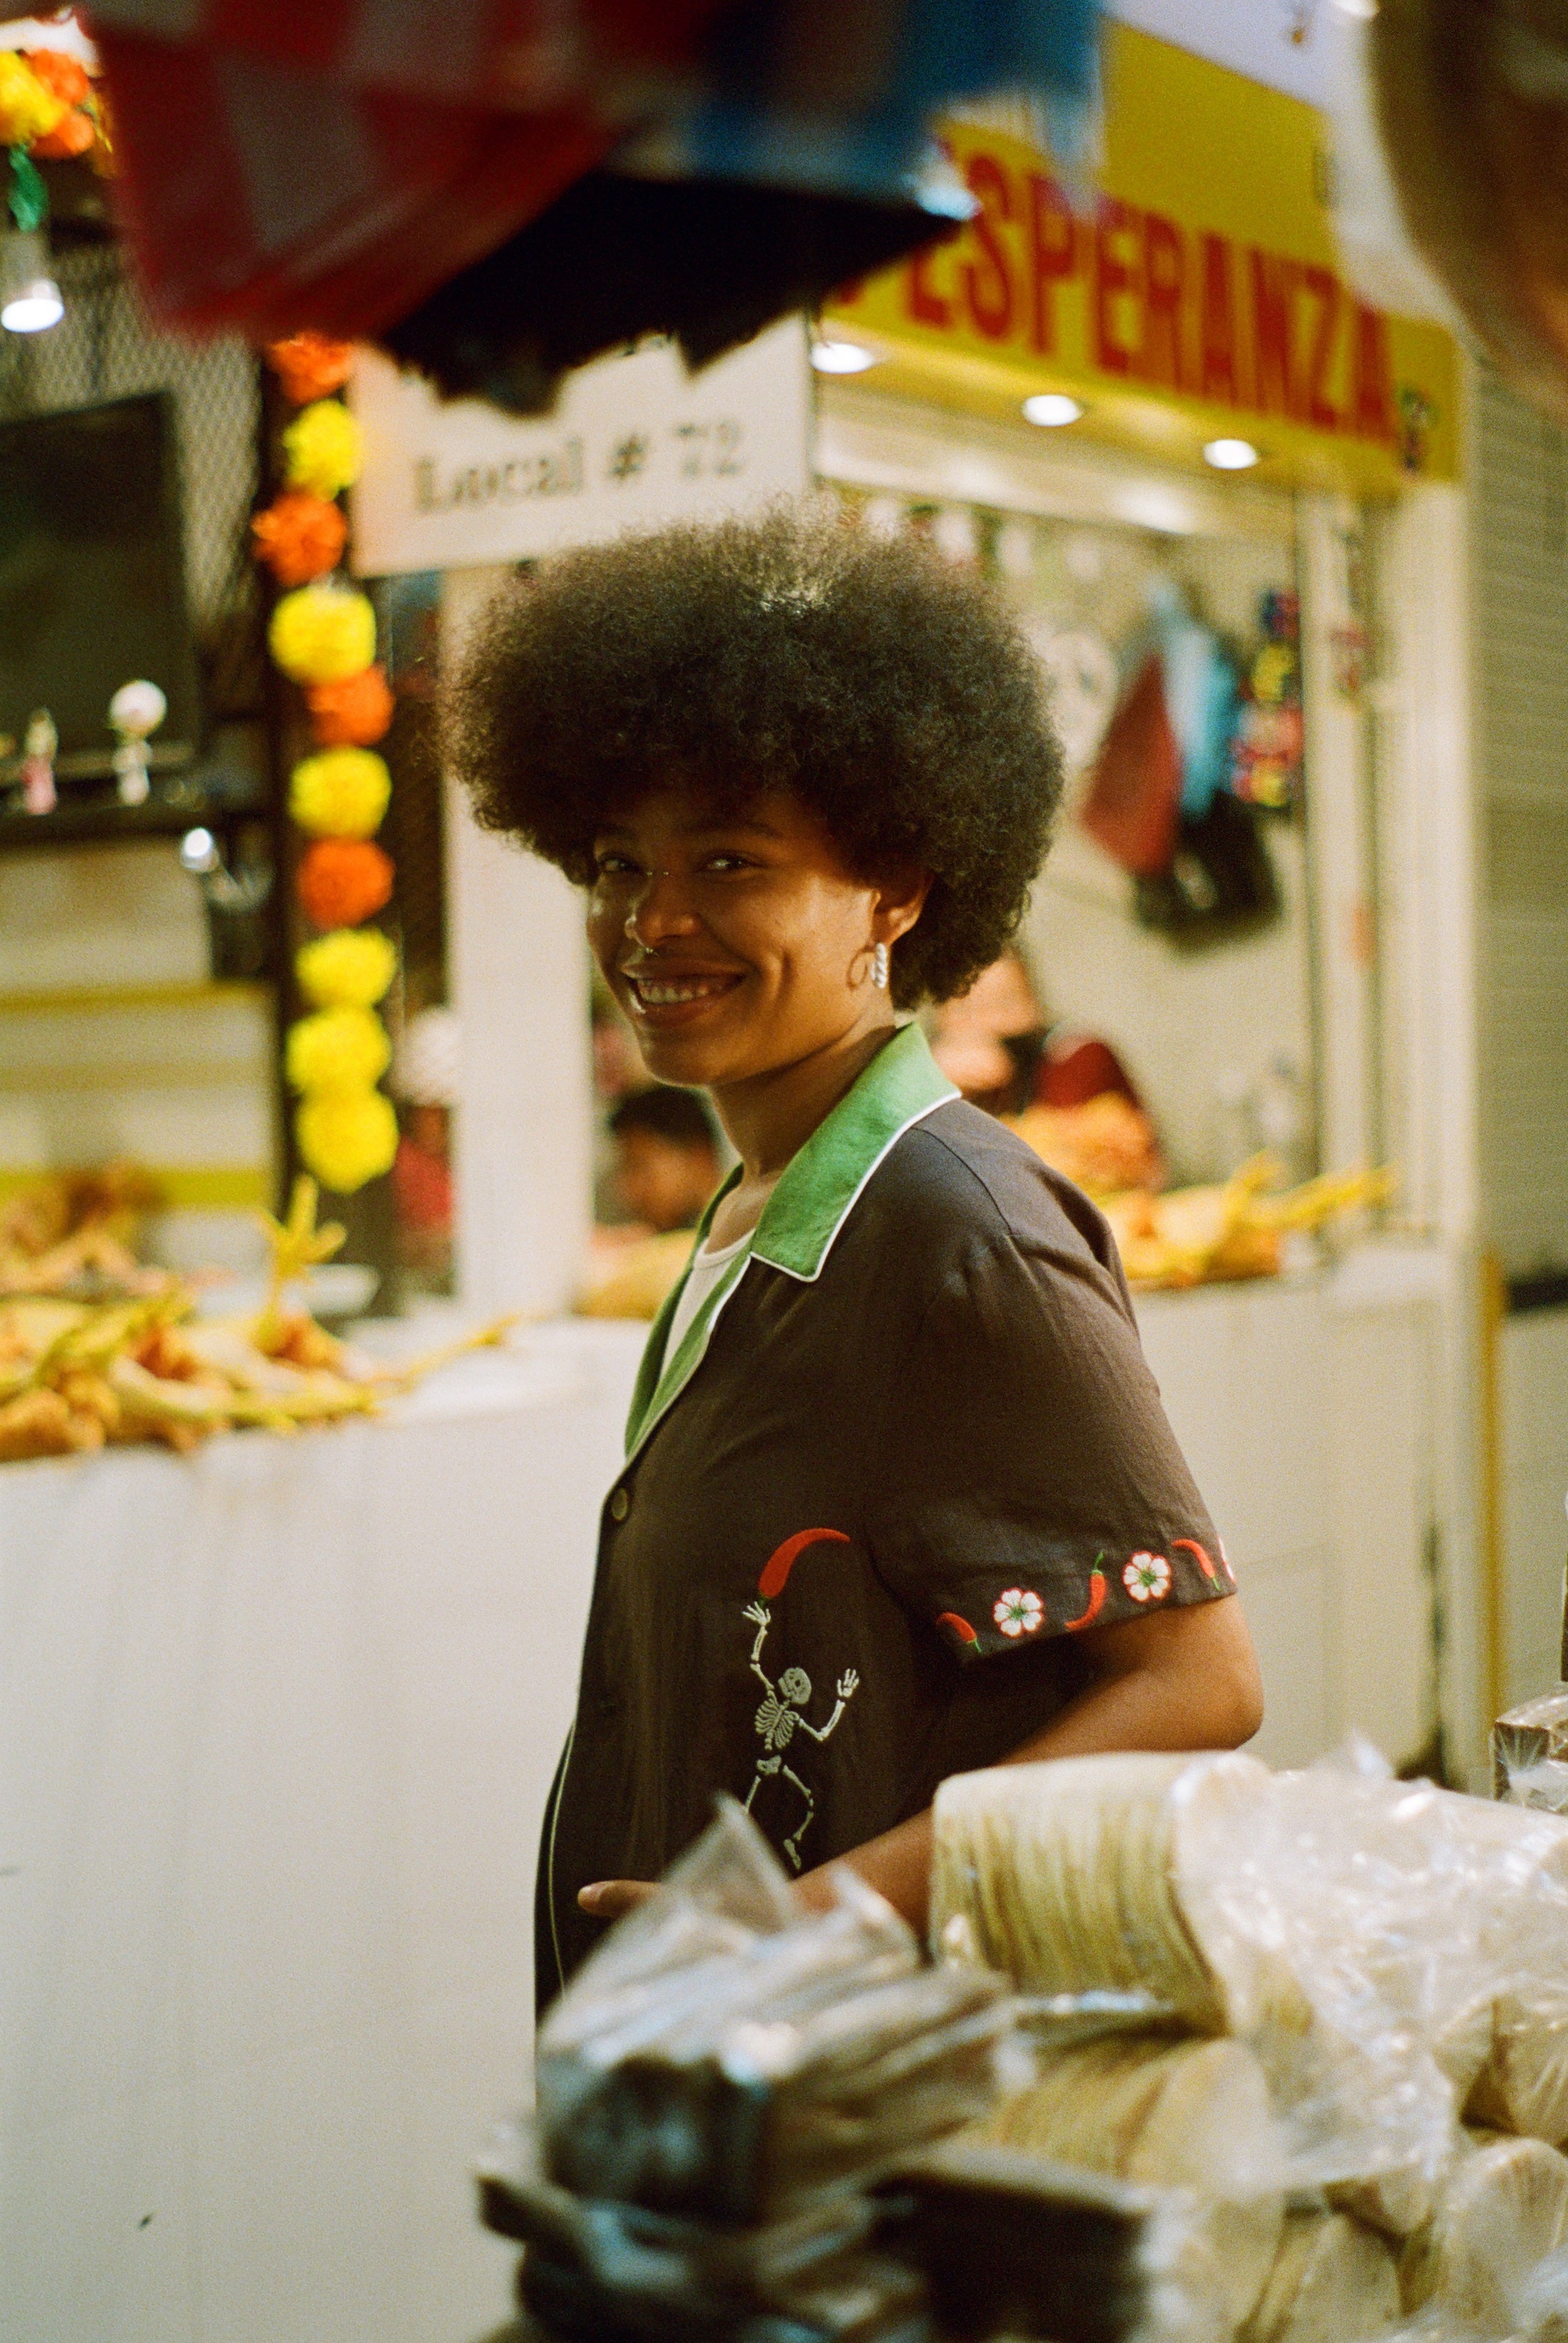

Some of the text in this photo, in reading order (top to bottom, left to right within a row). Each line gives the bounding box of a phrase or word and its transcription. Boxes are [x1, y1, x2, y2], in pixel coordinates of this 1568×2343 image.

[414, 418, 744, 515] Local # 72
